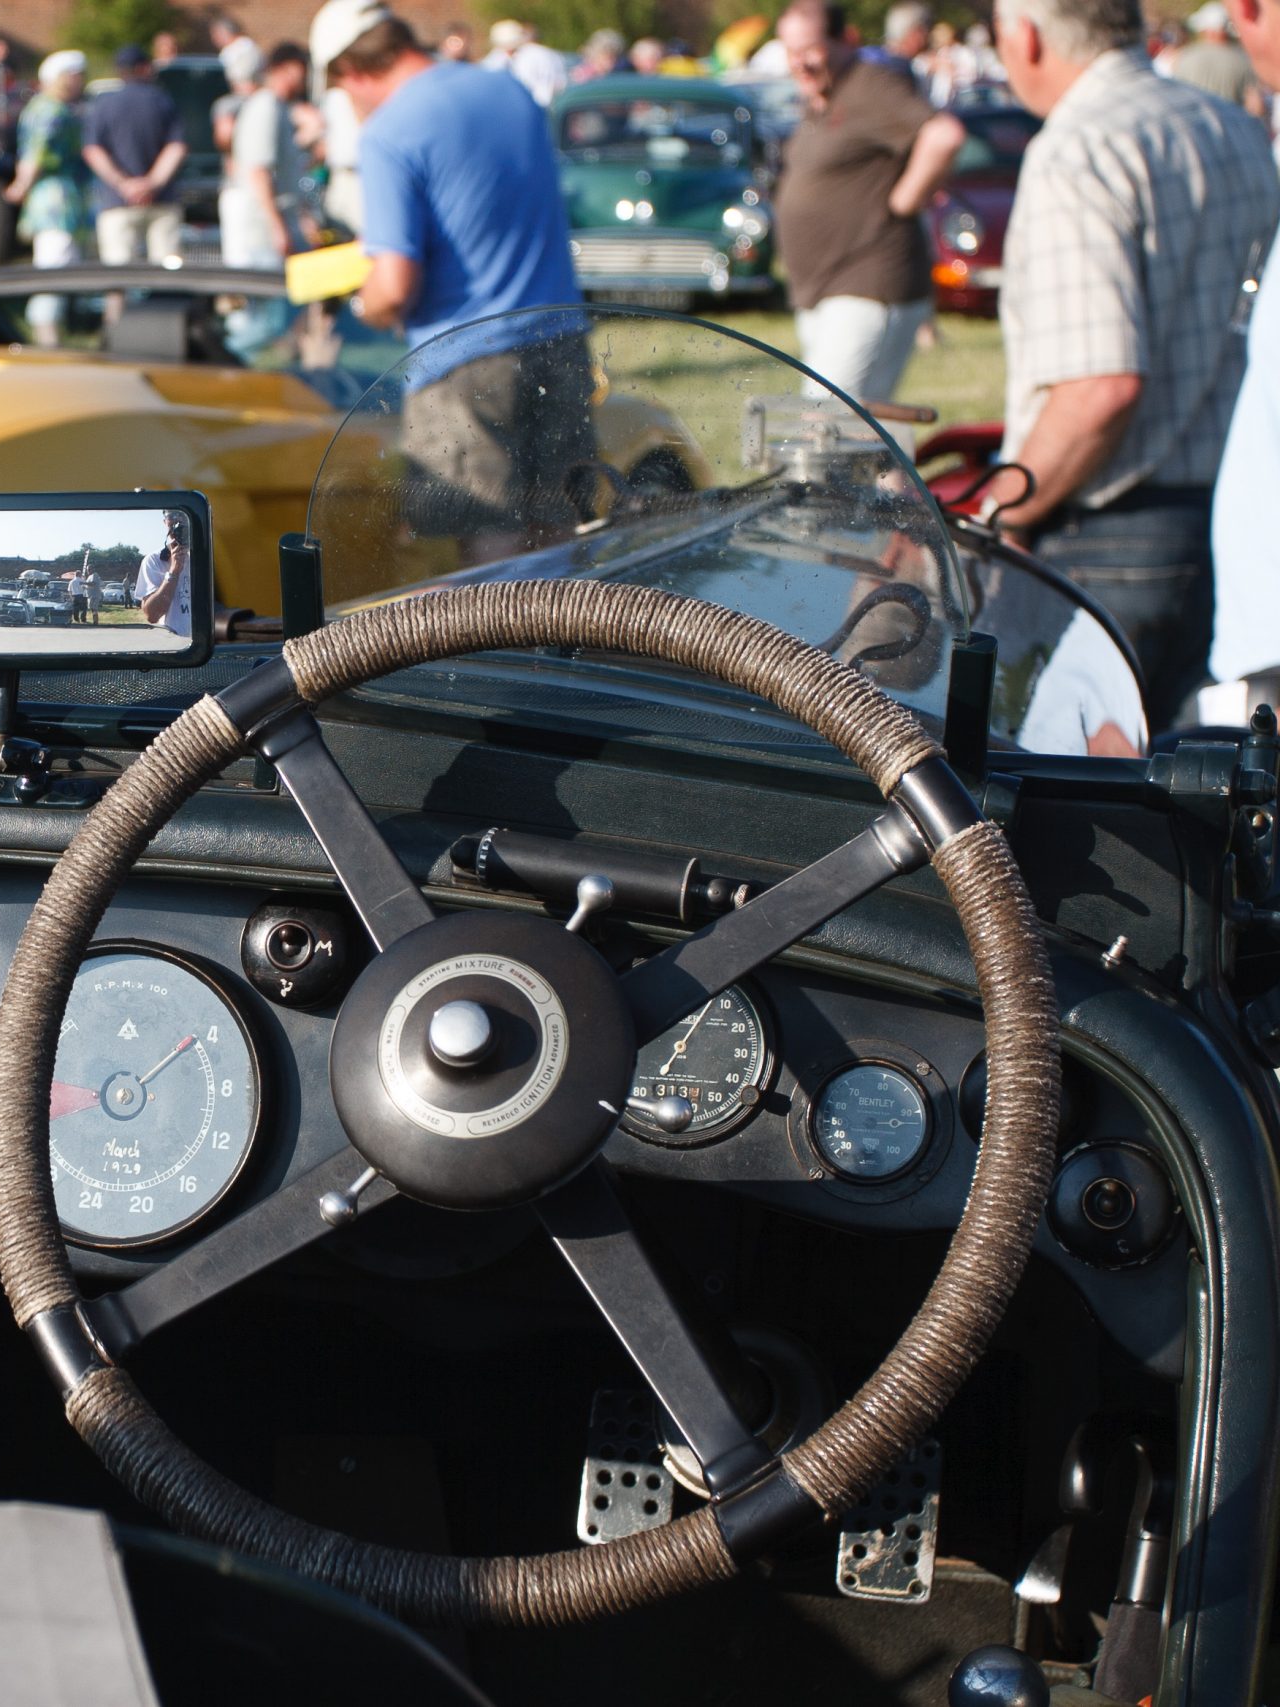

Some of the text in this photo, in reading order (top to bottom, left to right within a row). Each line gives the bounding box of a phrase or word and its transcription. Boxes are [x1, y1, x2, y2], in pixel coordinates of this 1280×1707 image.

[418, 966, 451, 987] STARTING
[455, 960, 506, 971] MIXTURE
[150, 984, 168, 996] 100
[720, 999, 731, 1009] 10
[731, 1023, 745, 1033] 20
[207, 1025, 218, 1043] 4
[734, 1049, 748, 1059] 30
[482, 1023, 560, 1127] RETARDED IGNITION ADVANCED
[725, 1073, 740, 1084] 40
[221, 1079, 233, 1098] 8
[633, 1087, 647, 1097] 80
[849, 1087, 860, 1096] 70
[877, 1083, 888, 1091] 80
[708, 1092, 722, 1102] 50
[836, 1102, 847, 1110] 60
[859, 1097, 896, 1108] BENTLEY
[901, 1109, 912, 1117] 90
[831, 1117, 842, 1126] 50
[833, 1130, 845, 1138] 40
[212, 1131, 230, 1150] 12
[840, 1141, 852, 1150] 30
[103, 1138, 140, 1157] March
[886, 1146, 900, 1154] 100
[103, 1161, 141, 1175] 1929
[179, 1175, 197, 1193] 16
[79, 1191, 103, 1209] 24
[129, 1196, 154, 1214] 20
